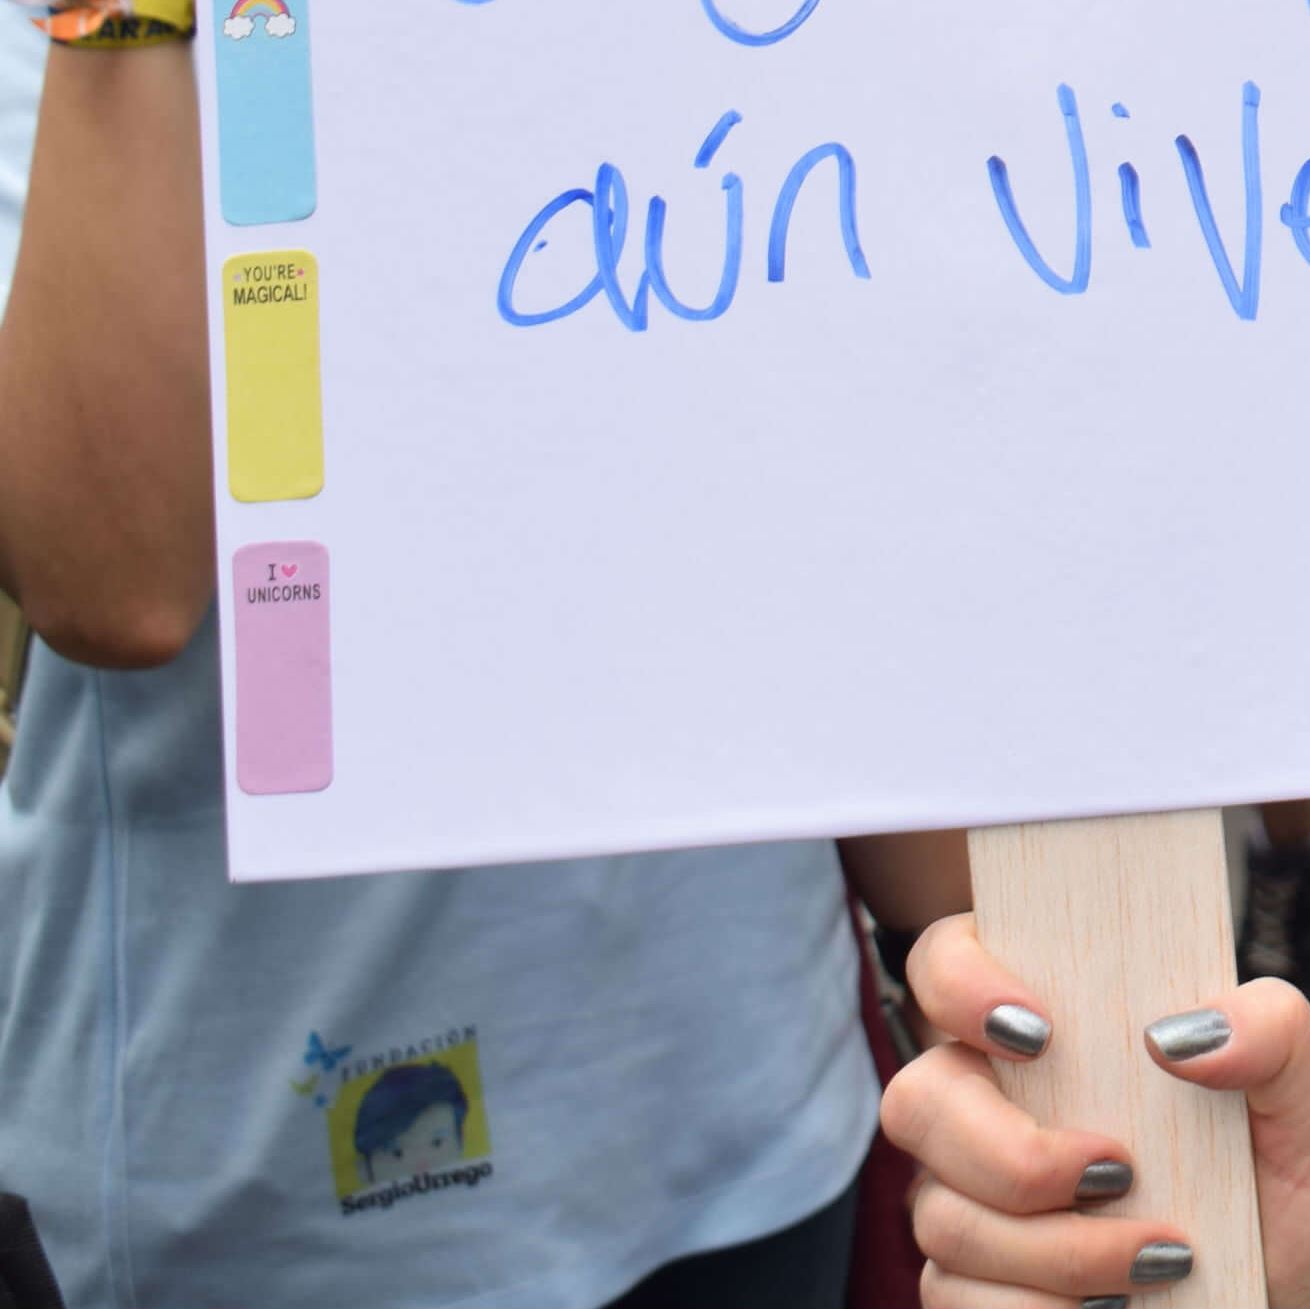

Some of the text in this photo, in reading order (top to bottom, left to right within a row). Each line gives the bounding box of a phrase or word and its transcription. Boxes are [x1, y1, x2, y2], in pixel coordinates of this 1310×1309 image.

[497, 110, 871, 332] aún
[244, 264, 296, 282] YOU'RE
[233, 284, 308, 306] MAGICAL!
[268, 564, 276, 581] I
[247, 583, 322, 604] UNICORNS
